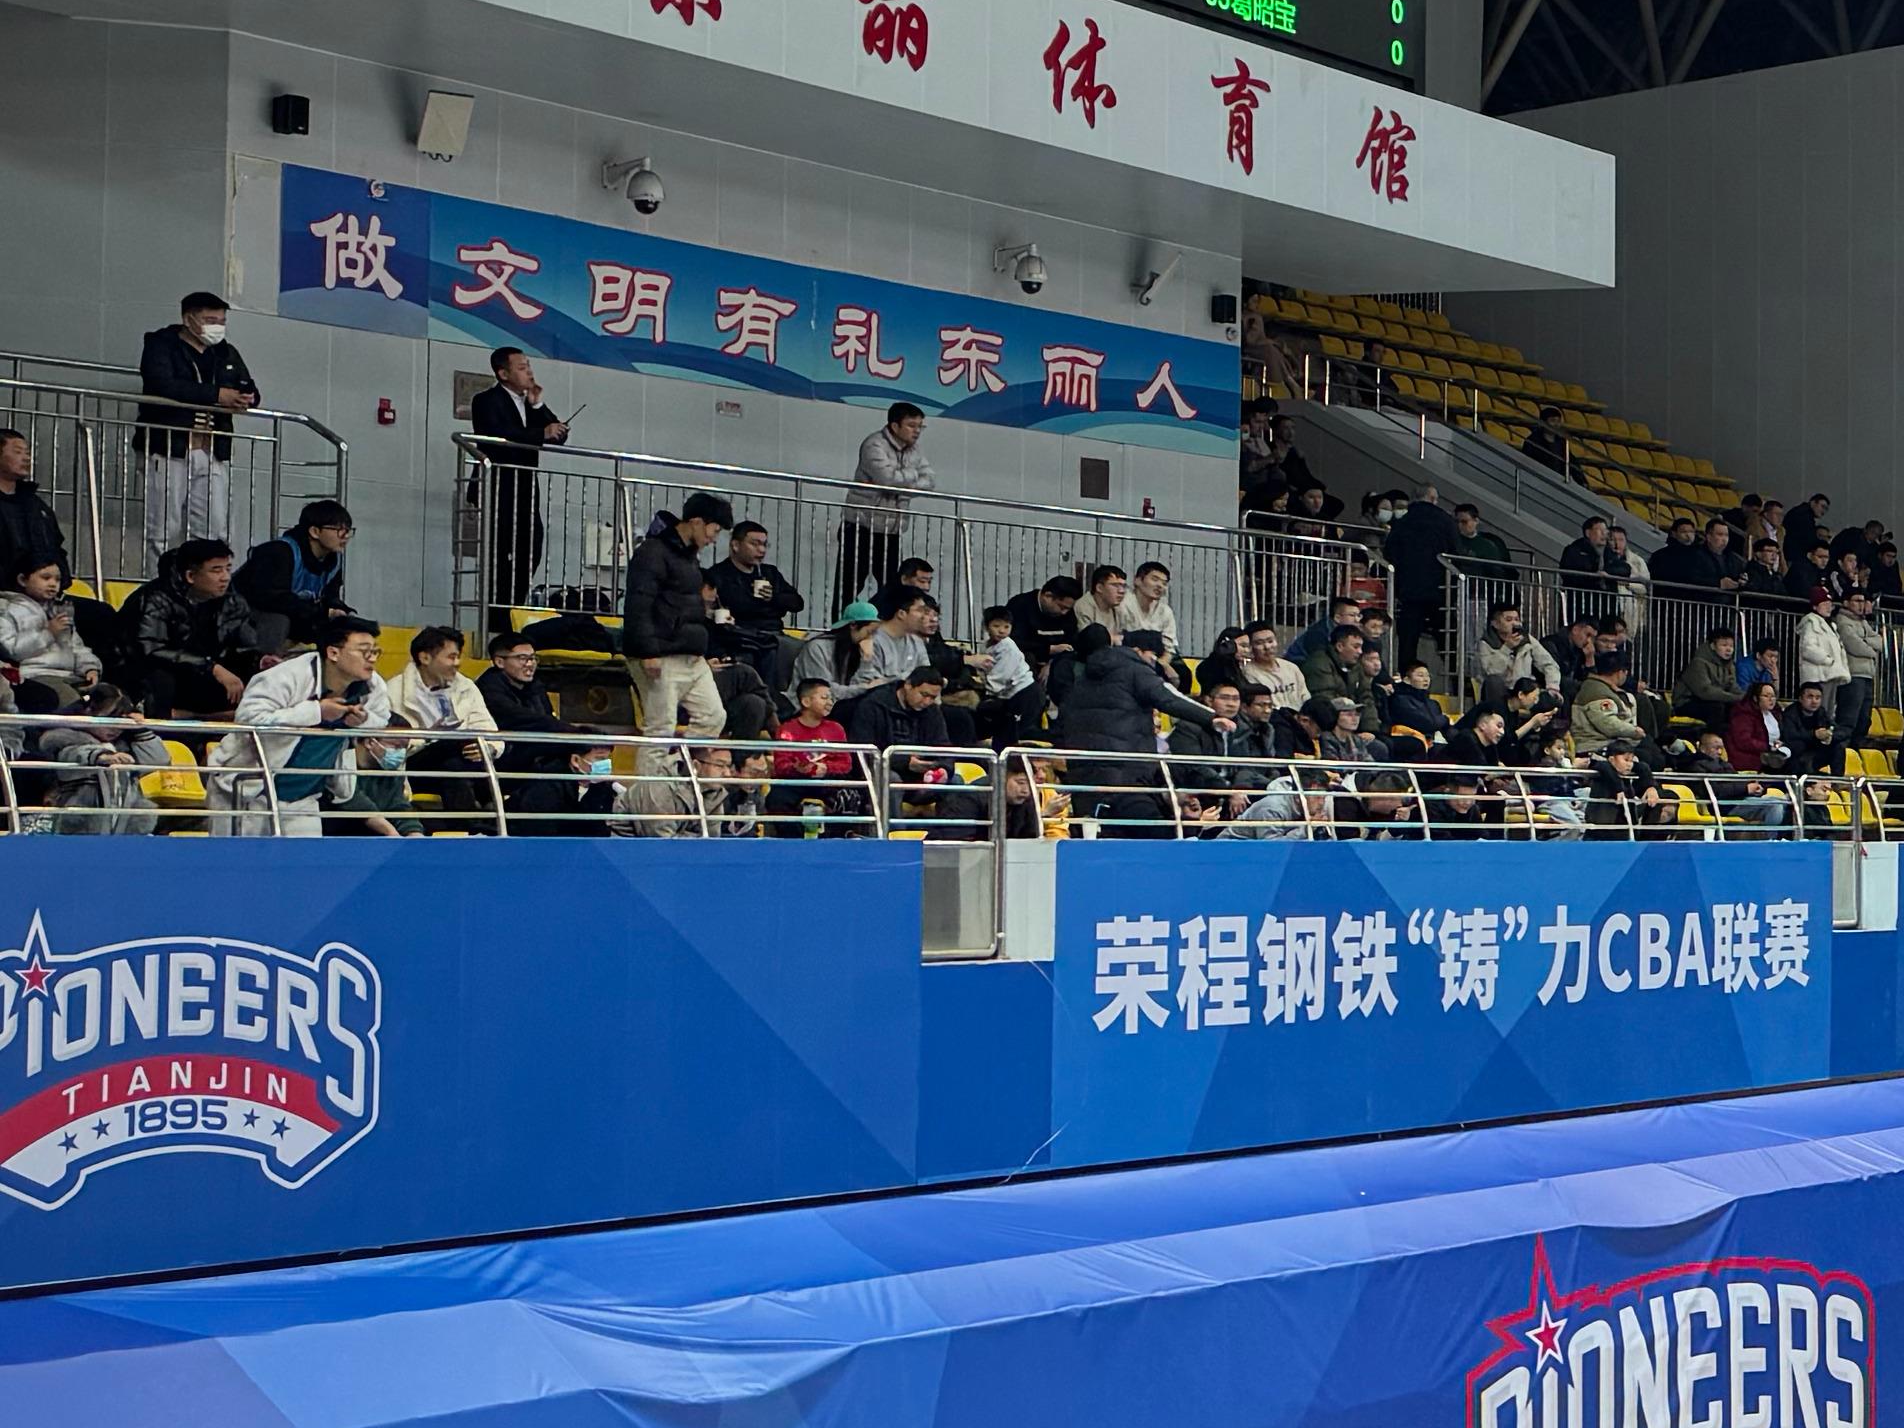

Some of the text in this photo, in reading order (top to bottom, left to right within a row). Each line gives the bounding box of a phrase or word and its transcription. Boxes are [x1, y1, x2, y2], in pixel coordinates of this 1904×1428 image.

[1391, 40, 1403, 65] 0
[310, 211, 1197, 422] 做文明有礼东丽人
[1090, 898, 1813, 1036] 荣程钢铁“铸”力CBA联赛
[61, 1061, 289, 1095] TIANJIN
[123, 1099, 228, 1138] 1895
